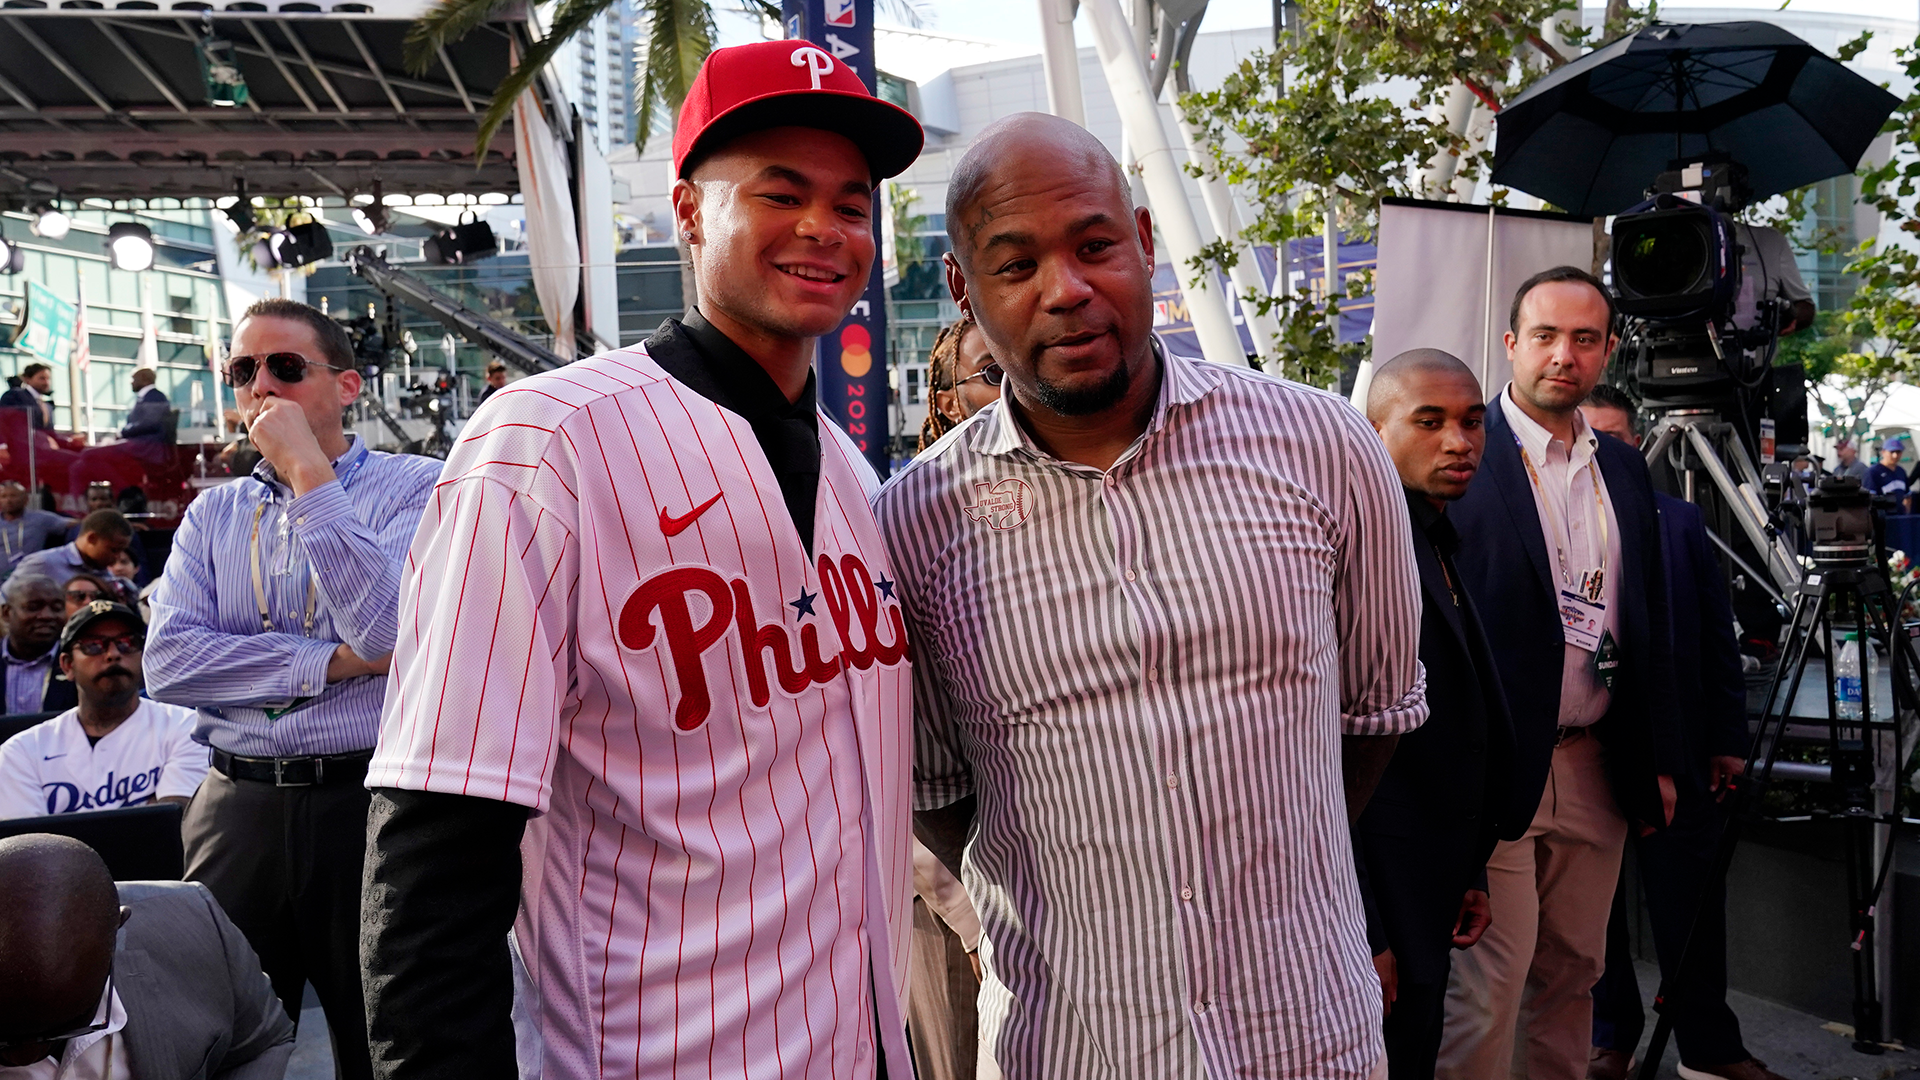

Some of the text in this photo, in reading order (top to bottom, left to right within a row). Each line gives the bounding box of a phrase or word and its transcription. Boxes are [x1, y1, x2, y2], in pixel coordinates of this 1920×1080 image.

[790, 46, 834, 90] P
[980, 497, 1002, 507] UVALDE
[990, 502, 1013, 513] STRONG
[89, 599, 113, 616] LA
[617, 553, 913, 733] Philli
[1597, 660, 1619, 671] SUNDAY
[1847, 687, 1862, 697] DA
